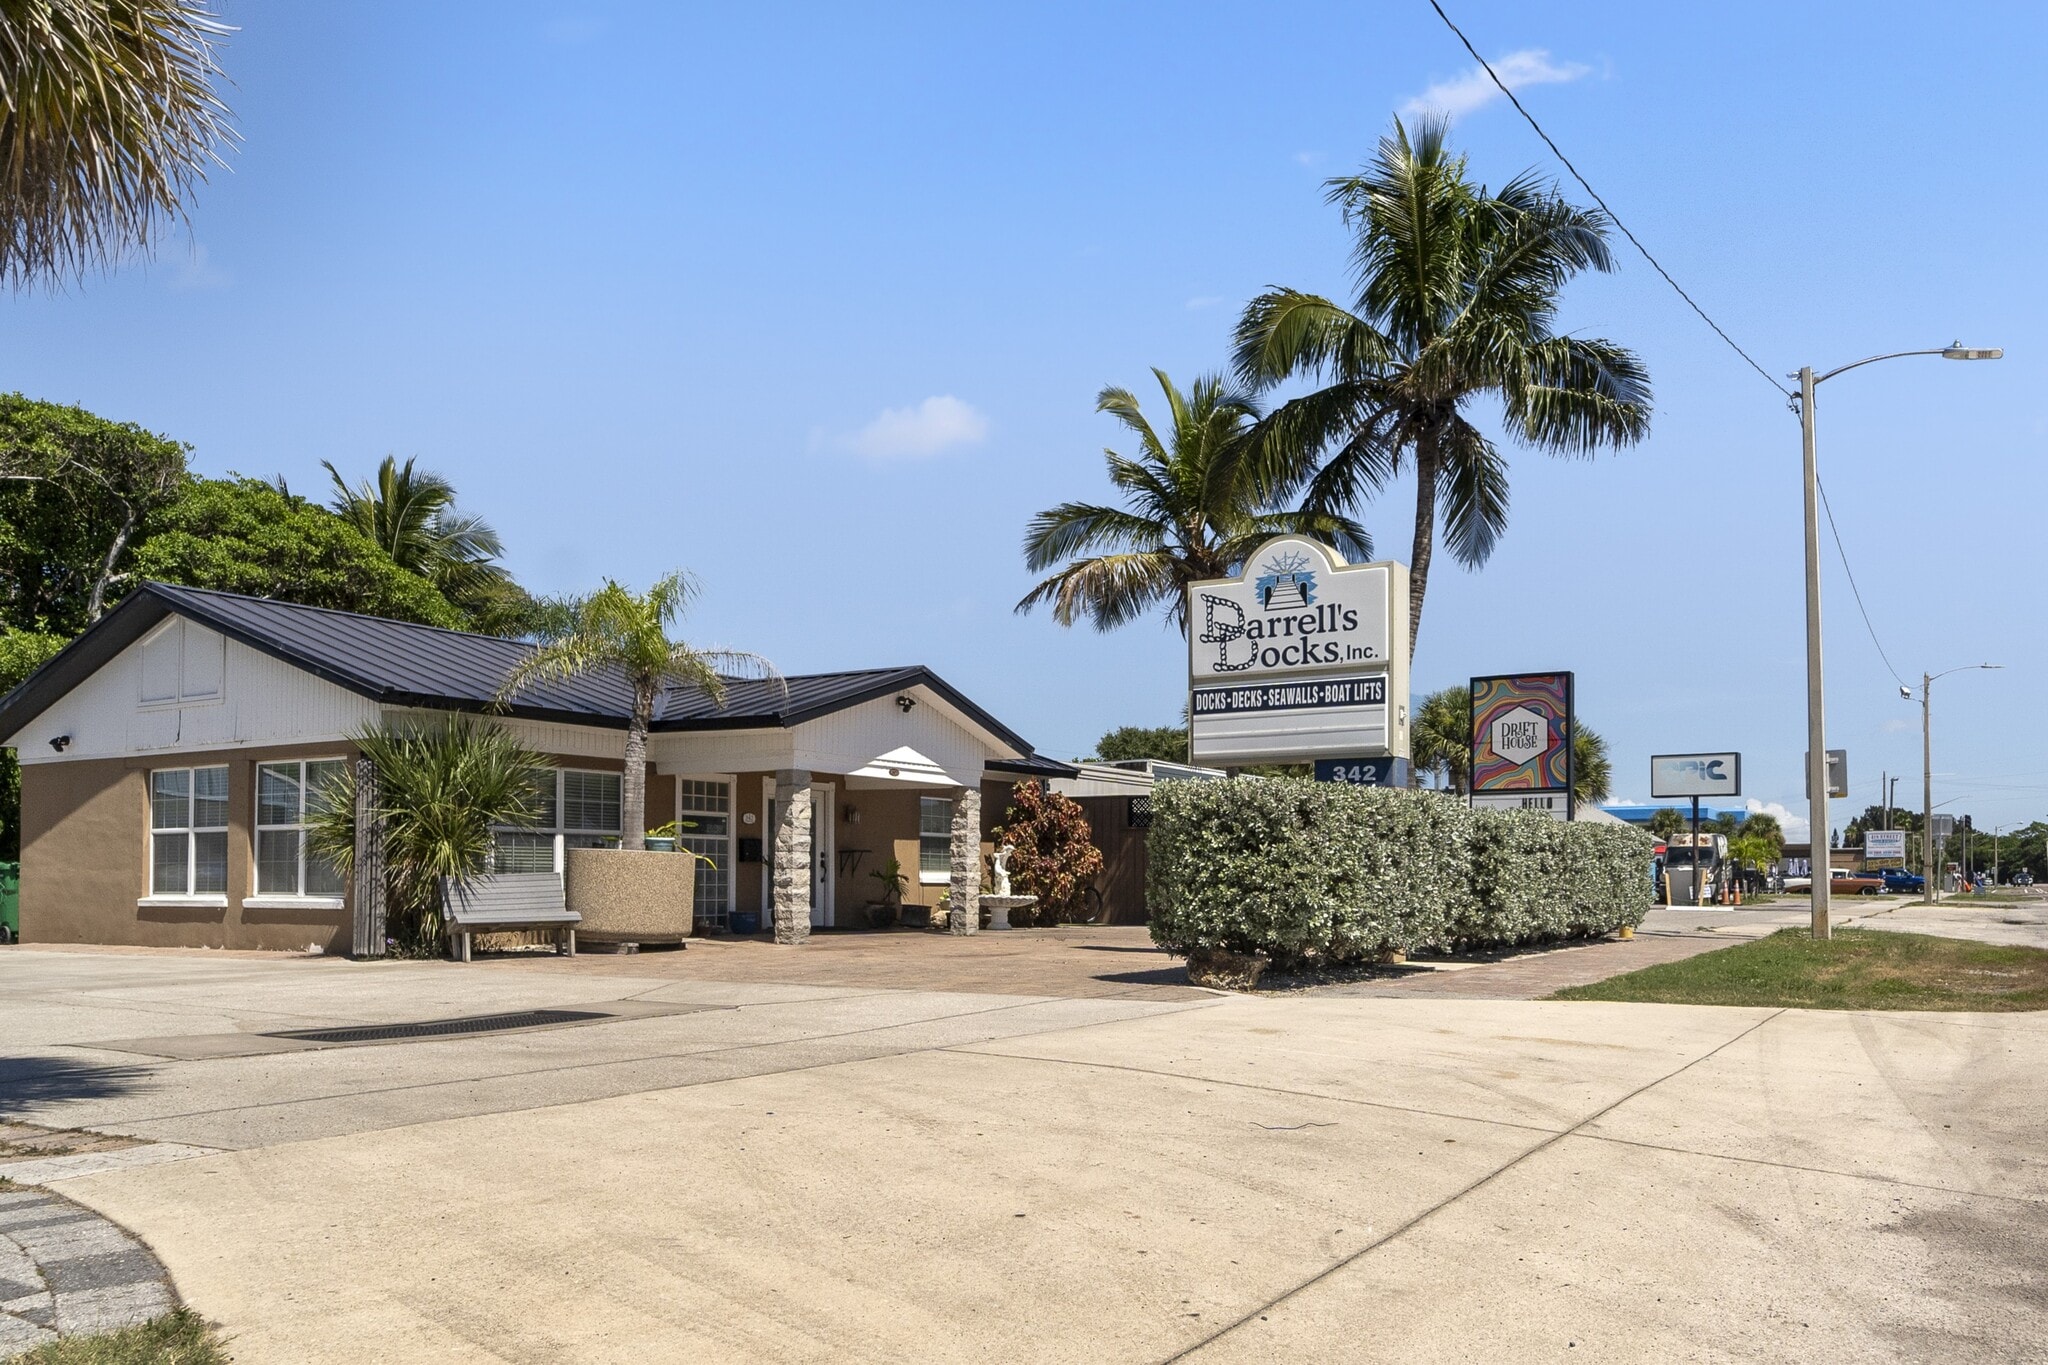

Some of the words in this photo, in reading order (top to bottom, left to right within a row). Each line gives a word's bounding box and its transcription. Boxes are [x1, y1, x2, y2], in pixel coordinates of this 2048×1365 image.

[1199, 593, 1358, 643] Darrell's
[1346, 644, 1379, 660] Inc.
[1196, 692, 1227, 711] DOCKS
[1232, 689, 1263, 709] DECKS
[1268, 685, 1319, 707] SEAWALLS
[1324, 683, 1351, 703] BOAT
[1354, 681, 1382, 702] LIFTS
[1501, 722, 1539, 738] DRIFT
[1502, 734, 1538, 750] HOUSE
[1332, 764, 1377, 782] 342
[1521, 797, 1553, 810] HELLO
